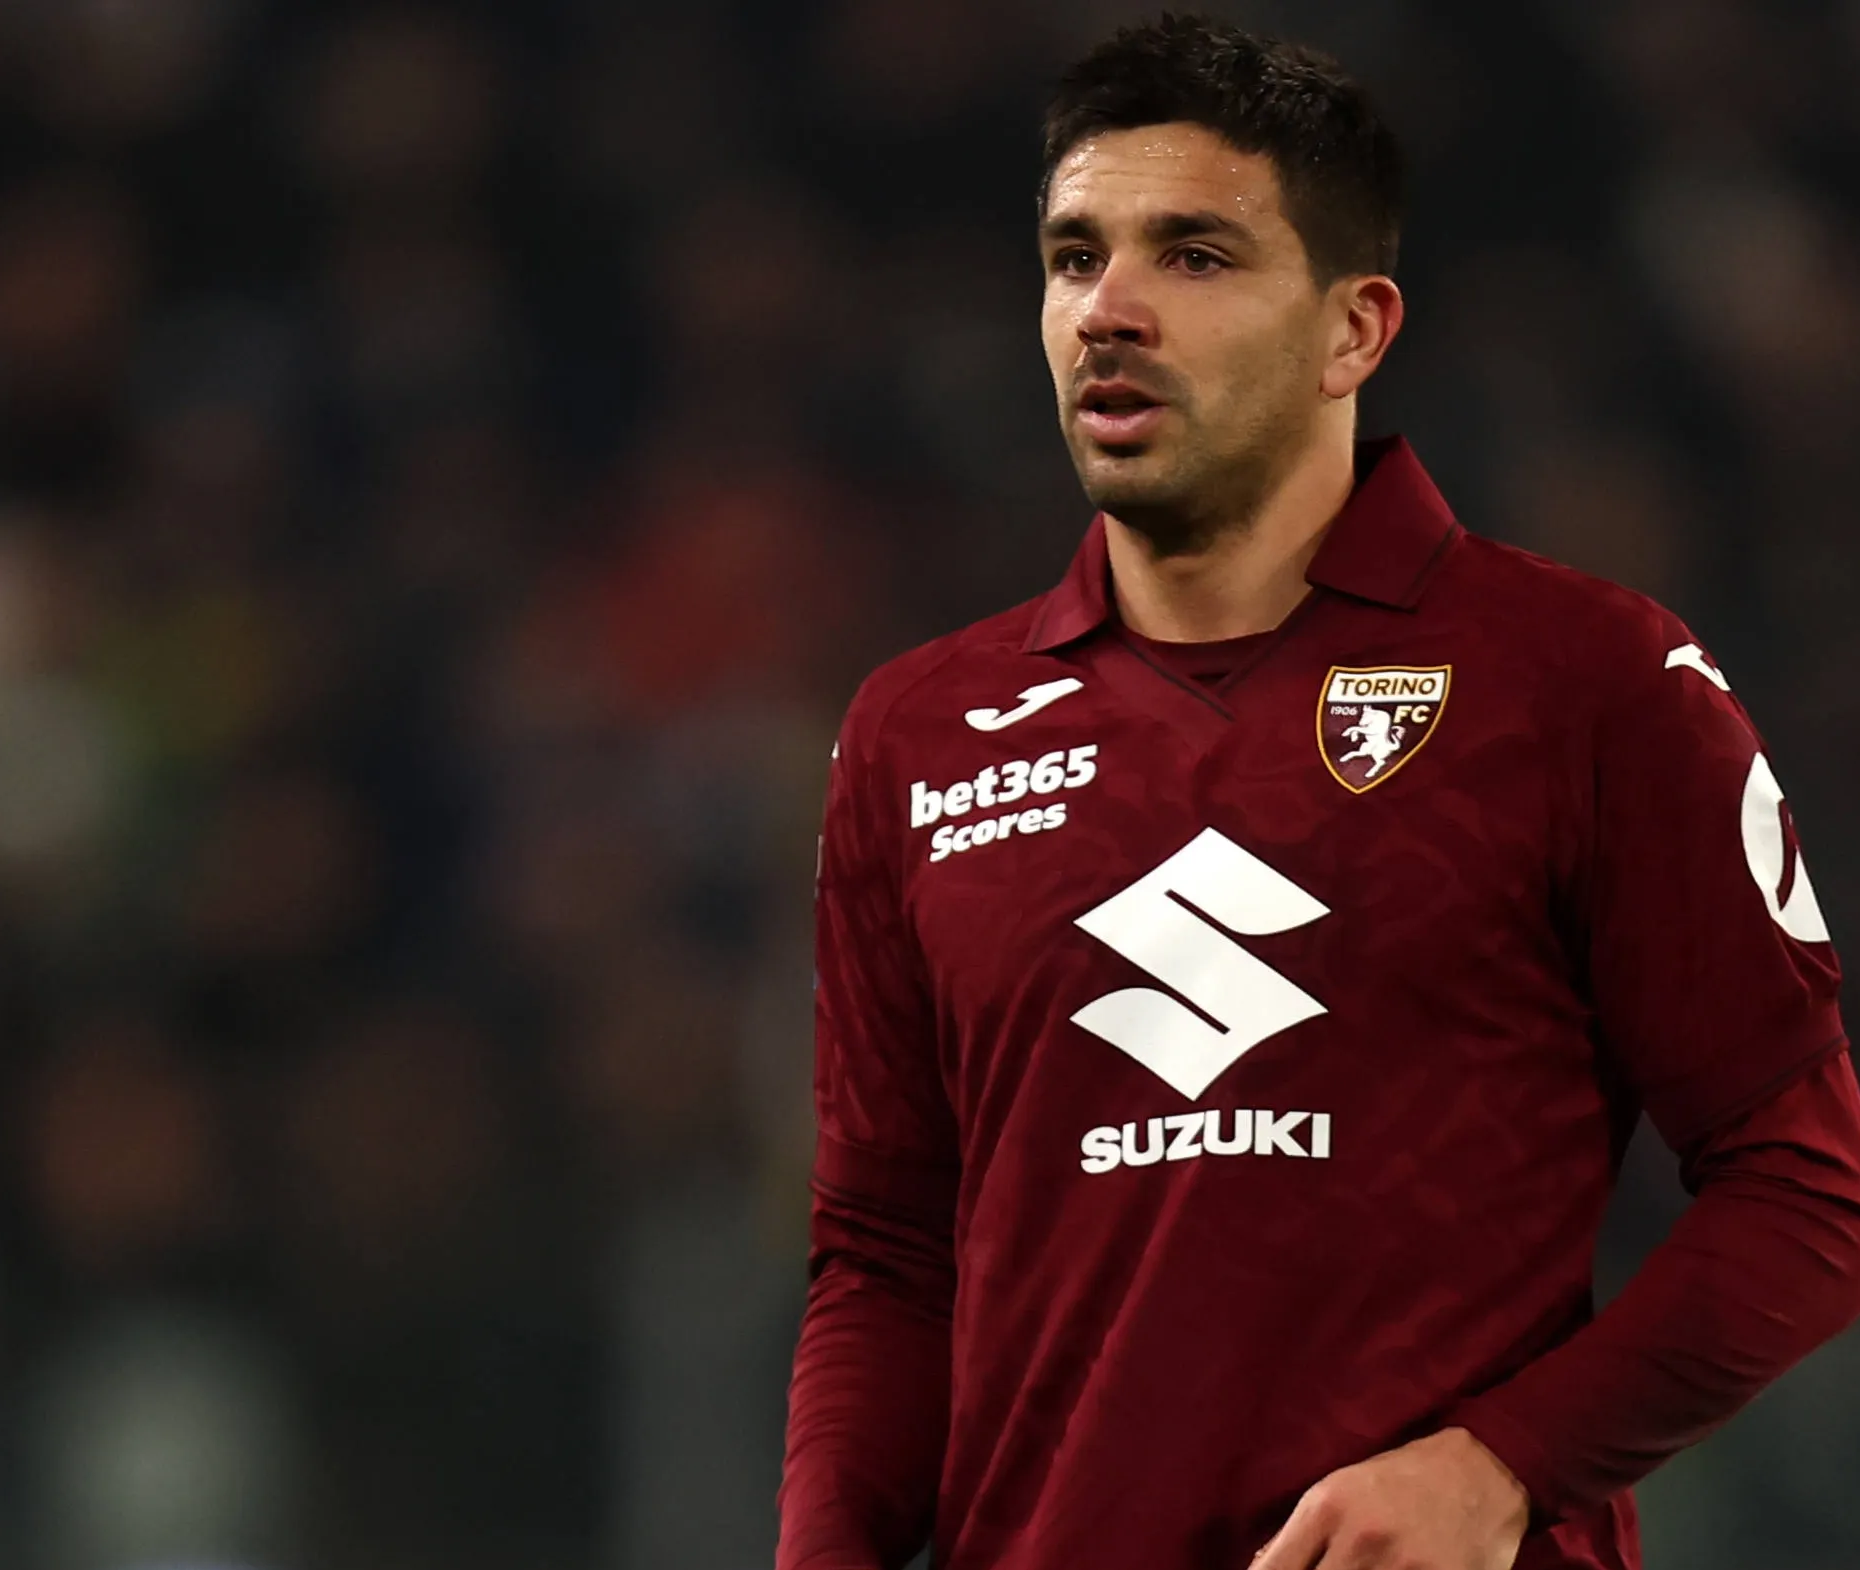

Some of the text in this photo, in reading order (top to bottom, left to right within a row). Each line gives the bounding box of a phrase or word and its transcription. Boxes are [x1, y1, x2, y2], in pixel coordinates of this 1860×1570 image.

[1339, 677, 1437, 697] TORINO
[1330, 705, 1358, 716] 1906
[1393, 704, 1431, 724] FC
[909, 744, 1098, 829] bet365
[929, 803, 1068, 863] Scores
[1079, 1108, 1332, 1175] SUZUKI
